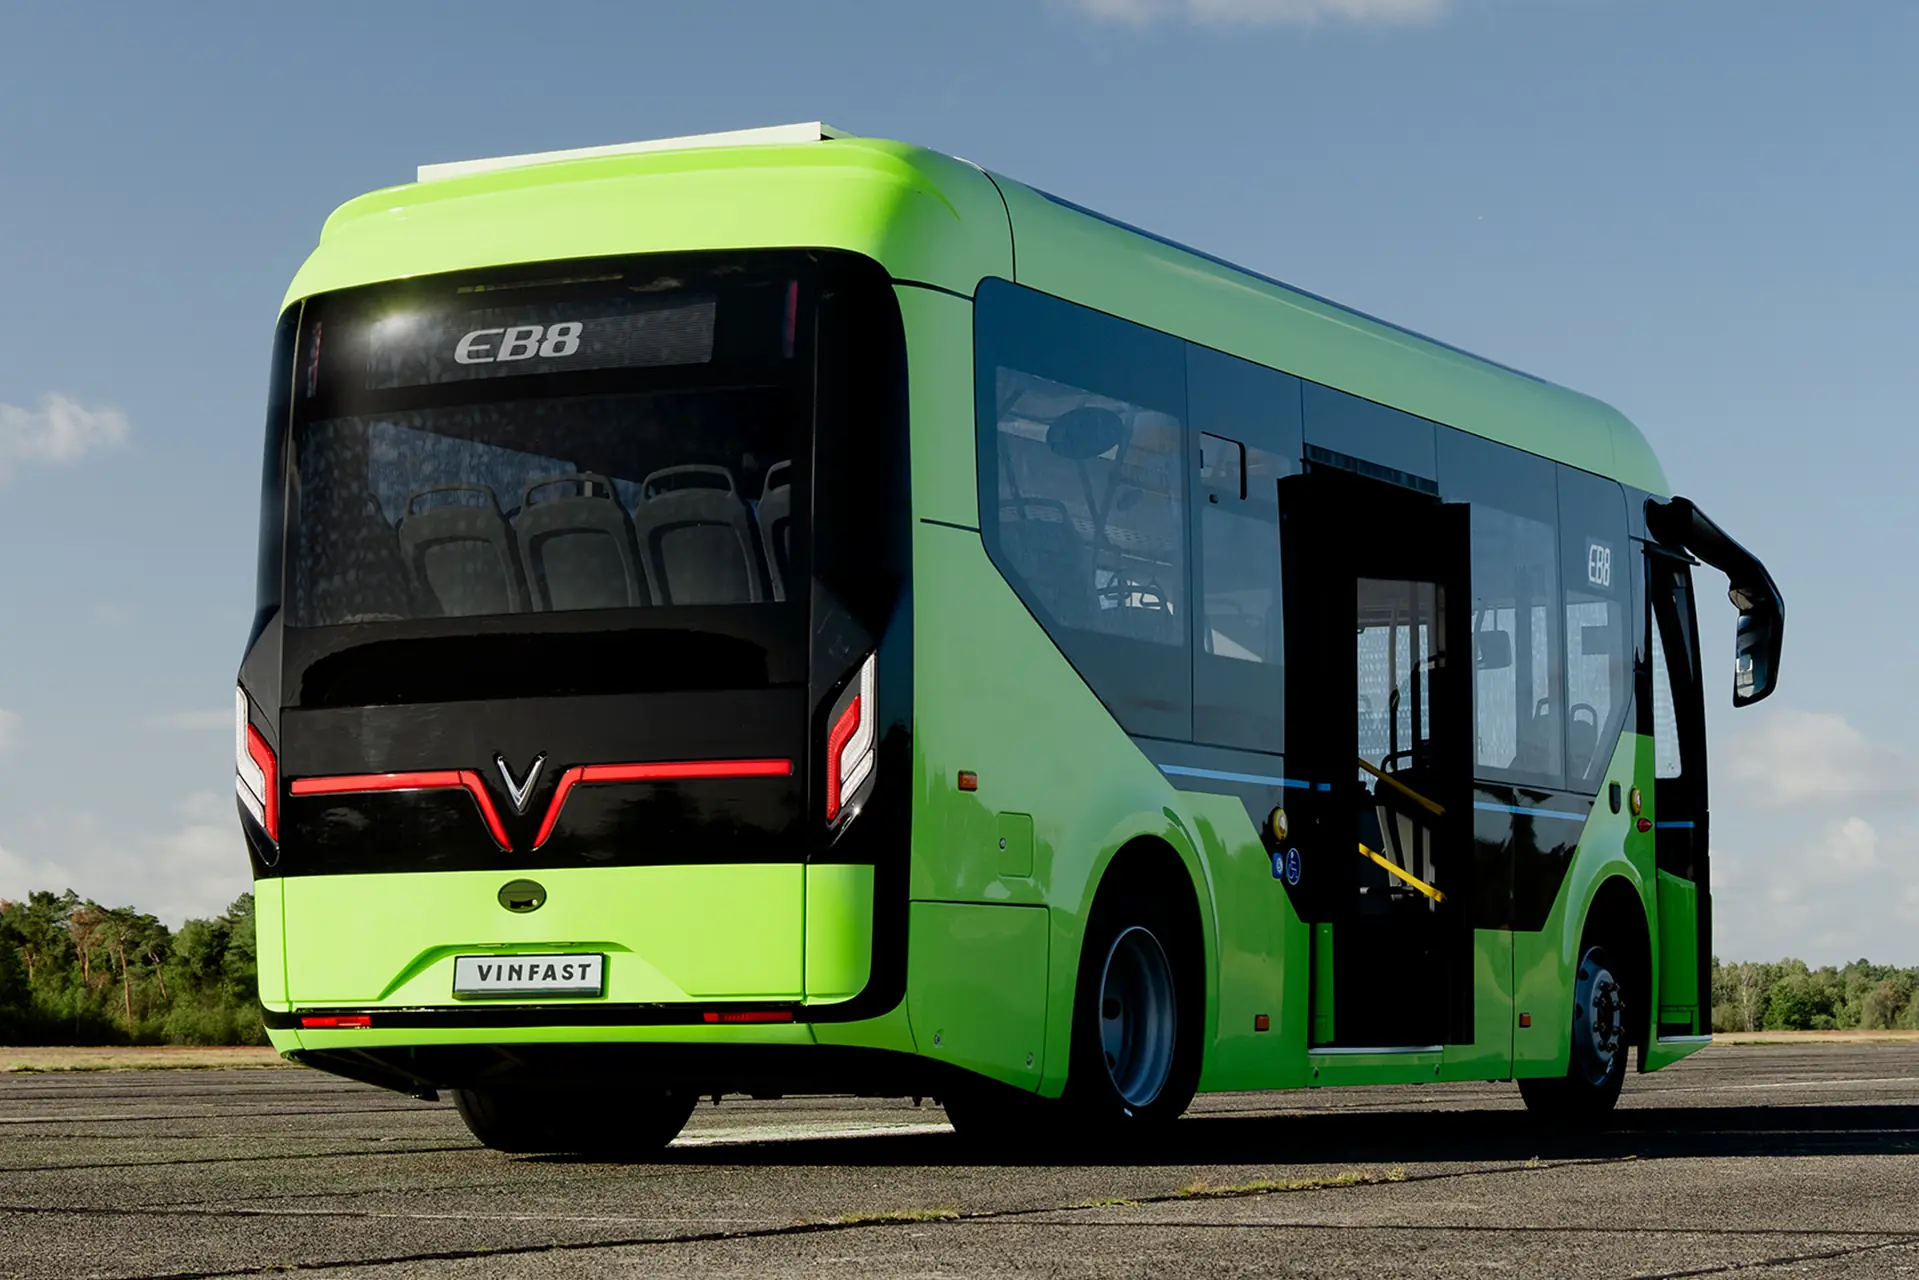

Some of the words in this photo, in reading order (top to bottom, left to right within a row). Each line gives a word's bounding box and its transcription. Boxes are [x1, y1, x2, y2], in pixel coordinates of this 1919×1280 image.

[454, 321, 583, 364] EB8
[1588, 544, 1611, 587] EB8
[477, 963, 592, 982] VINFAST
